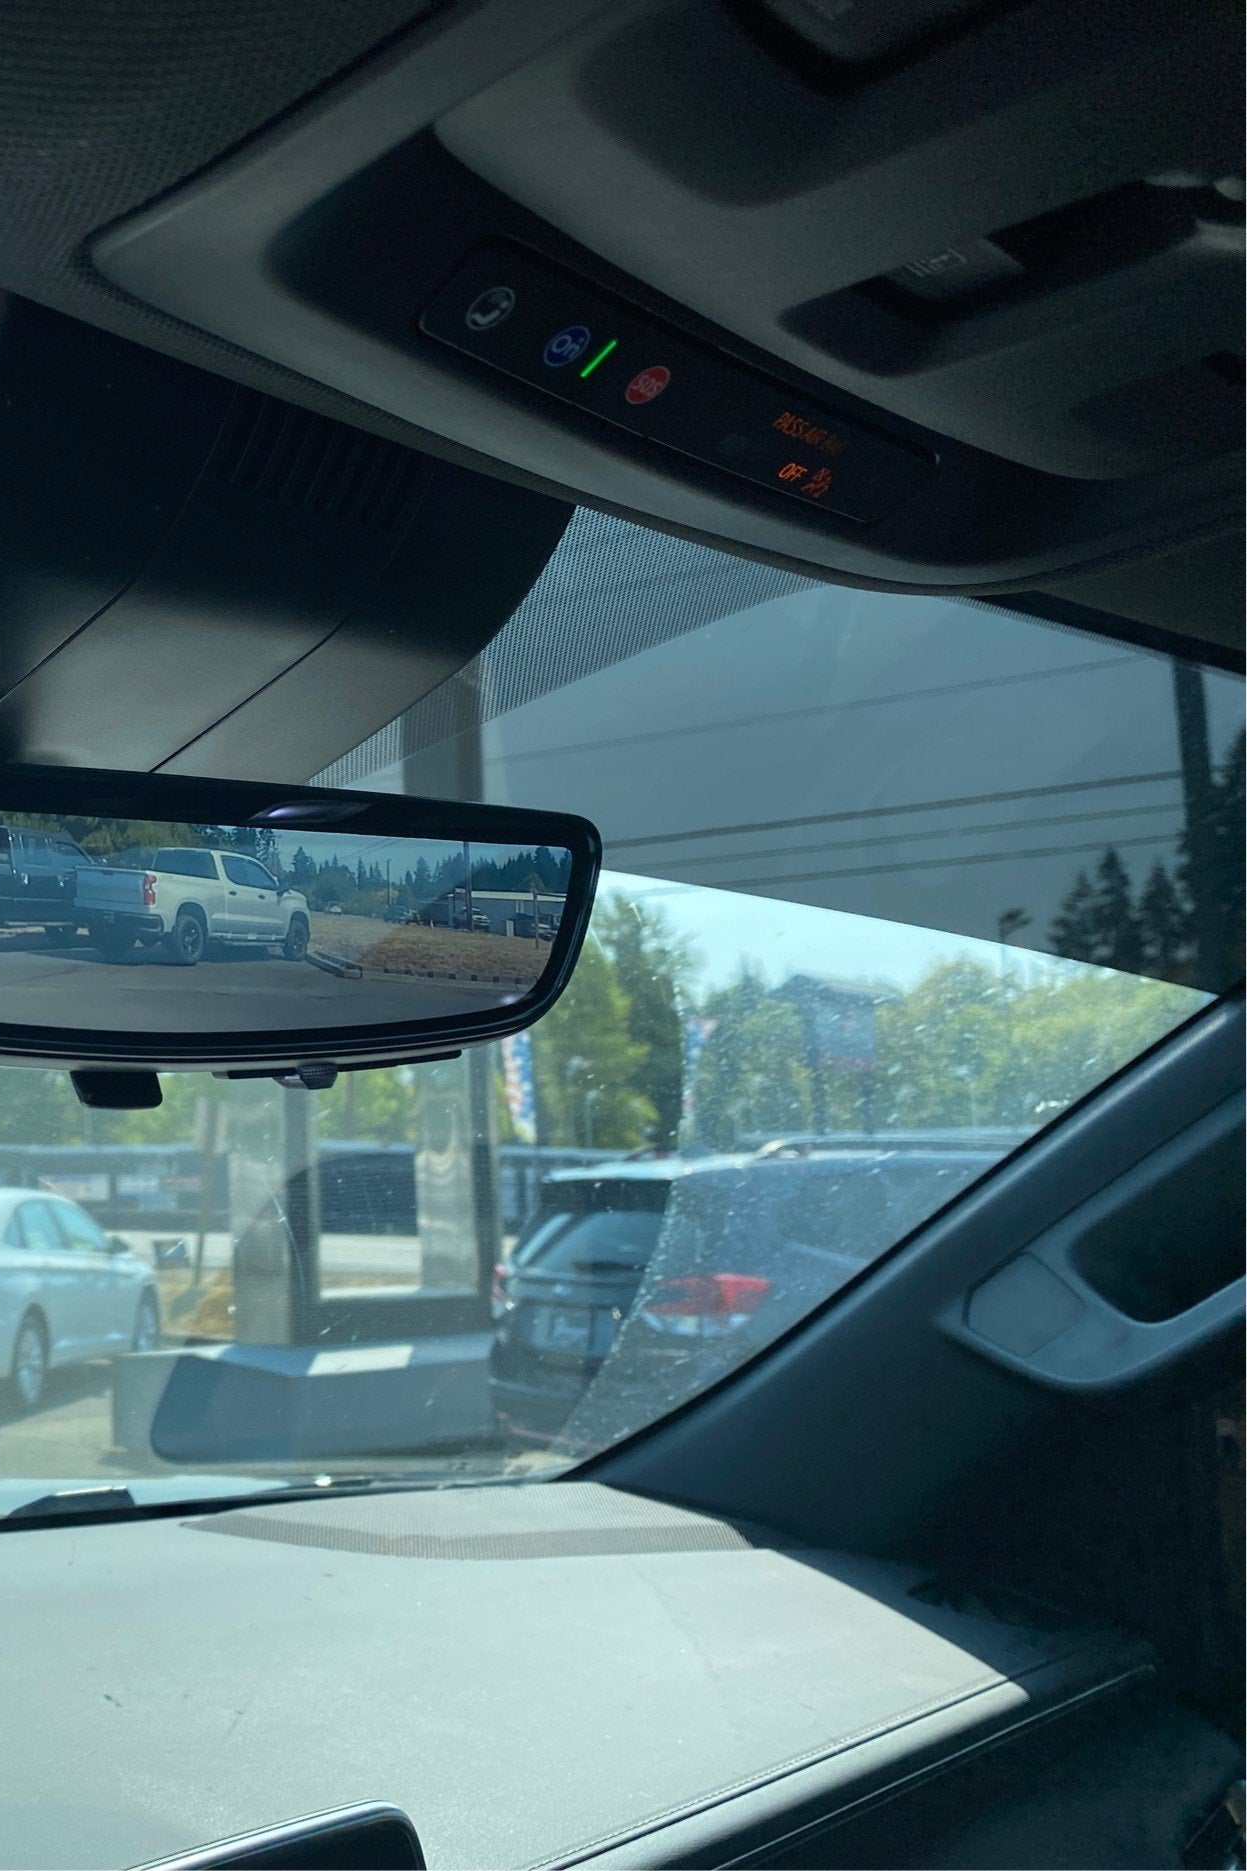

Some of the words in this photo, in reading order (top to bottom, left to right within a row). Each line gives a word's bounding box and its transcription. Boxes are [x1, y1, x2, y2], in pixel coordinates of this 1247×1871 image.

[631, 374, 665, 396] SOS
[772, 412, 810, 437] PASS
[777, 462, 808, 481] OFF
